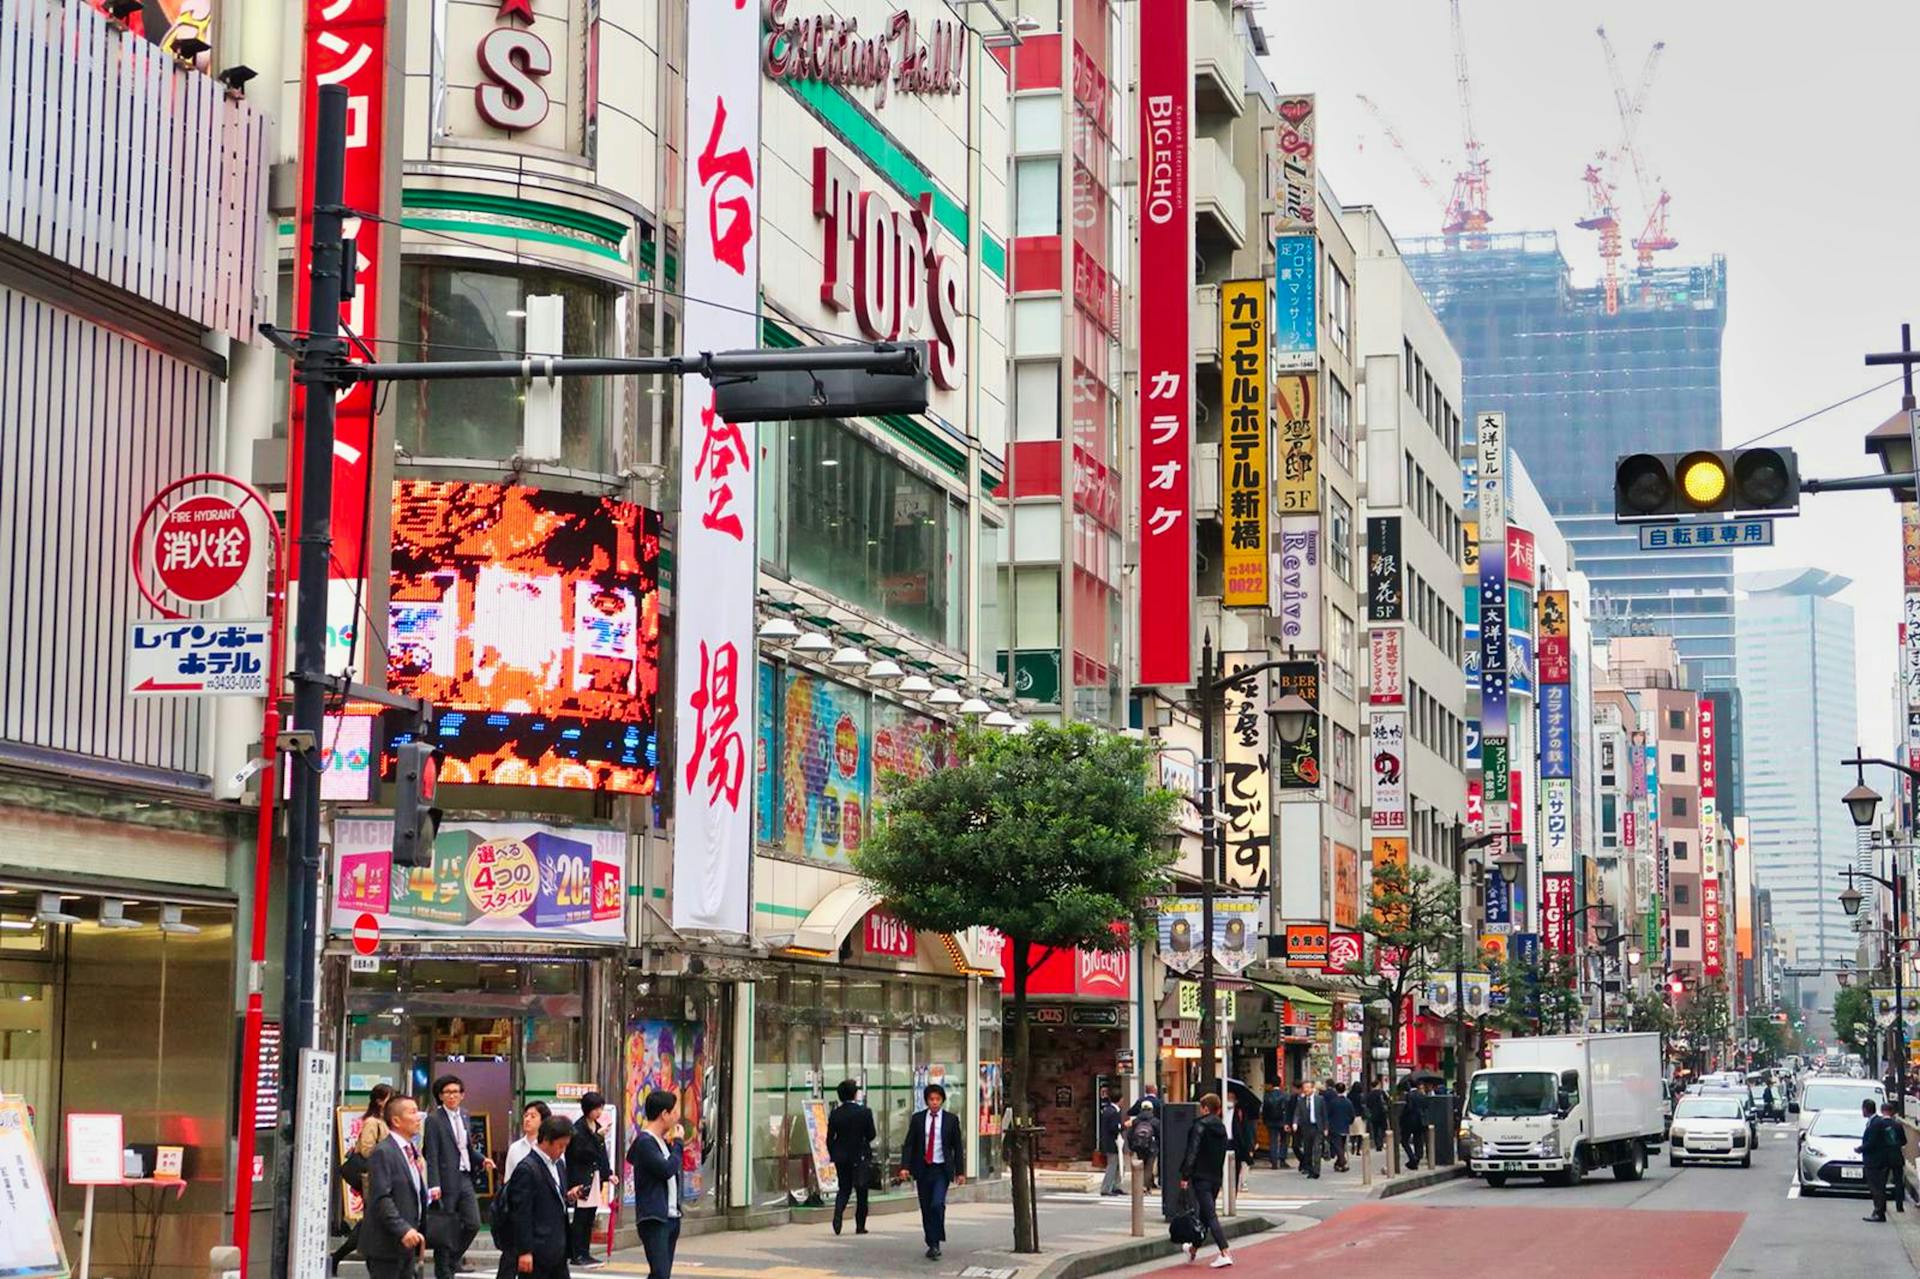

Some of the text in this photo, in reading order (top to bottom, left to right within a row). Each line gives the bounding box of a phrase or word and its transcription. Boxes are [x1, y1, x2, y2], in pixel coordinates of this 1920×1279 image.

[475, 27, 552, 130] S
[1148, 95, 1174, 224] BIG ECHO
[1230, 292, 1260, 550] カプセルホテル新橋
[1148, 370, 1182, 535] カラオケ
[1284, 490, 1312, 509] 5F
[171, 508, 236, 523] FIRE HYDRANT
[1650, 524, 1763, 546] 自転車専用
[163, 527, 245, 571] 消火栓
[1282, 531, 1308, 636] Revive
[1376, 606, 1394, 618] 5F
[134, 625, 263, 649] レインボー
[178, 652, 261, 675] ホテル
[1549, 800, 1566, 848] サウナ
[477, 843, 521, 864] 選べる
[473, 863, 531, 891] 4つの
[481, 888, 533, 909] スタイル
